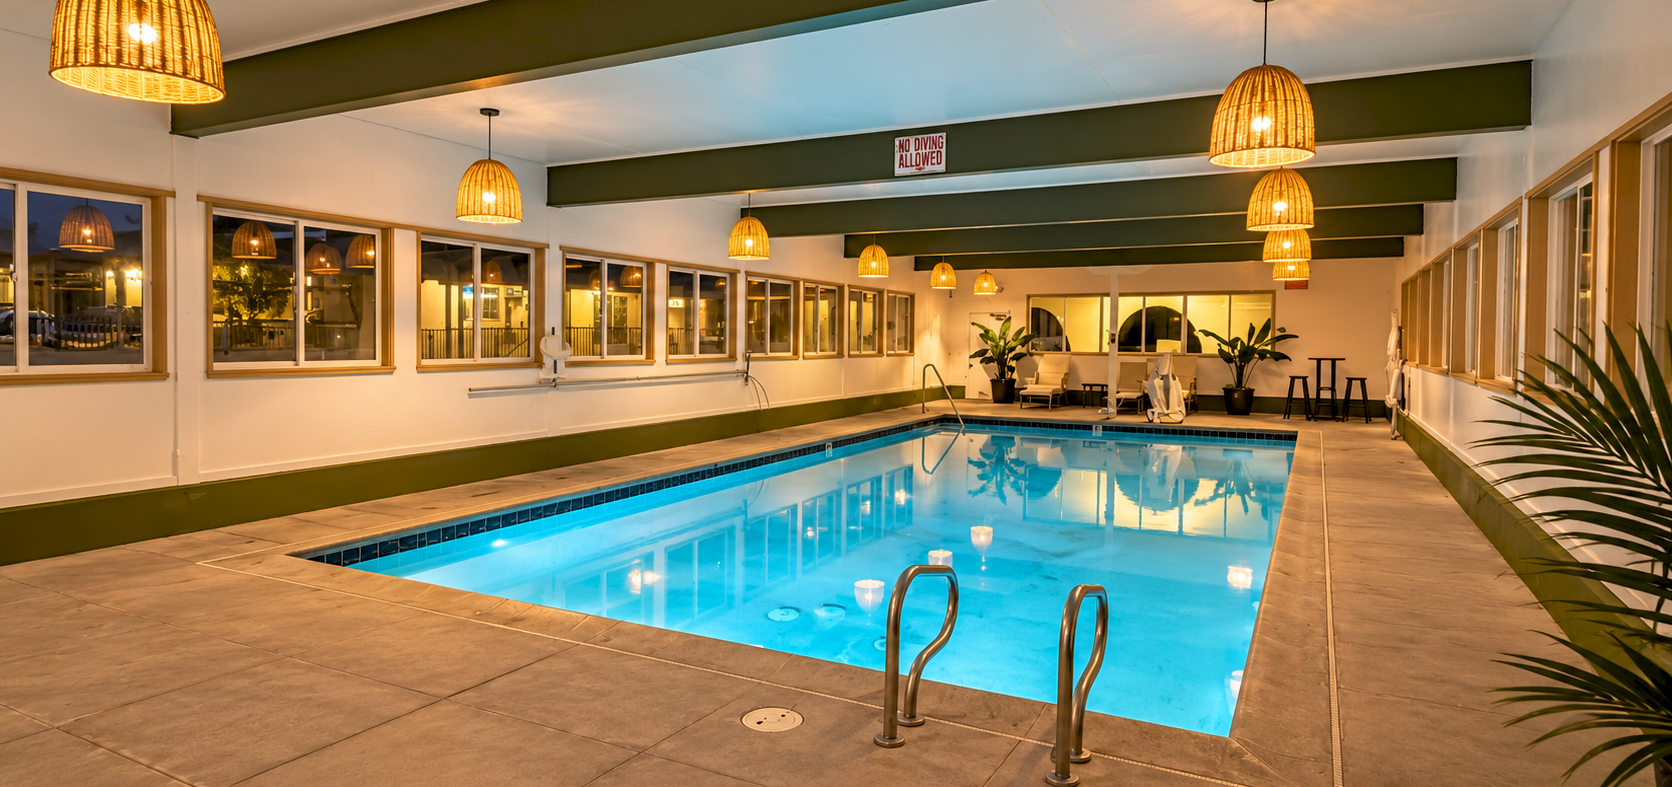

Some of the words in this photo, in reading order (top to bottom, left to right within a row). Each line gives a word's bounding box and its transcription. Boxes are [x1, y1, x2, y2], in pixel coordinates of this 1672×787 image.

[898, 138, 910, 153] NO
[914, 135, 944, 151] DIVING
[898, 150, 942, 168] ALLOWED
